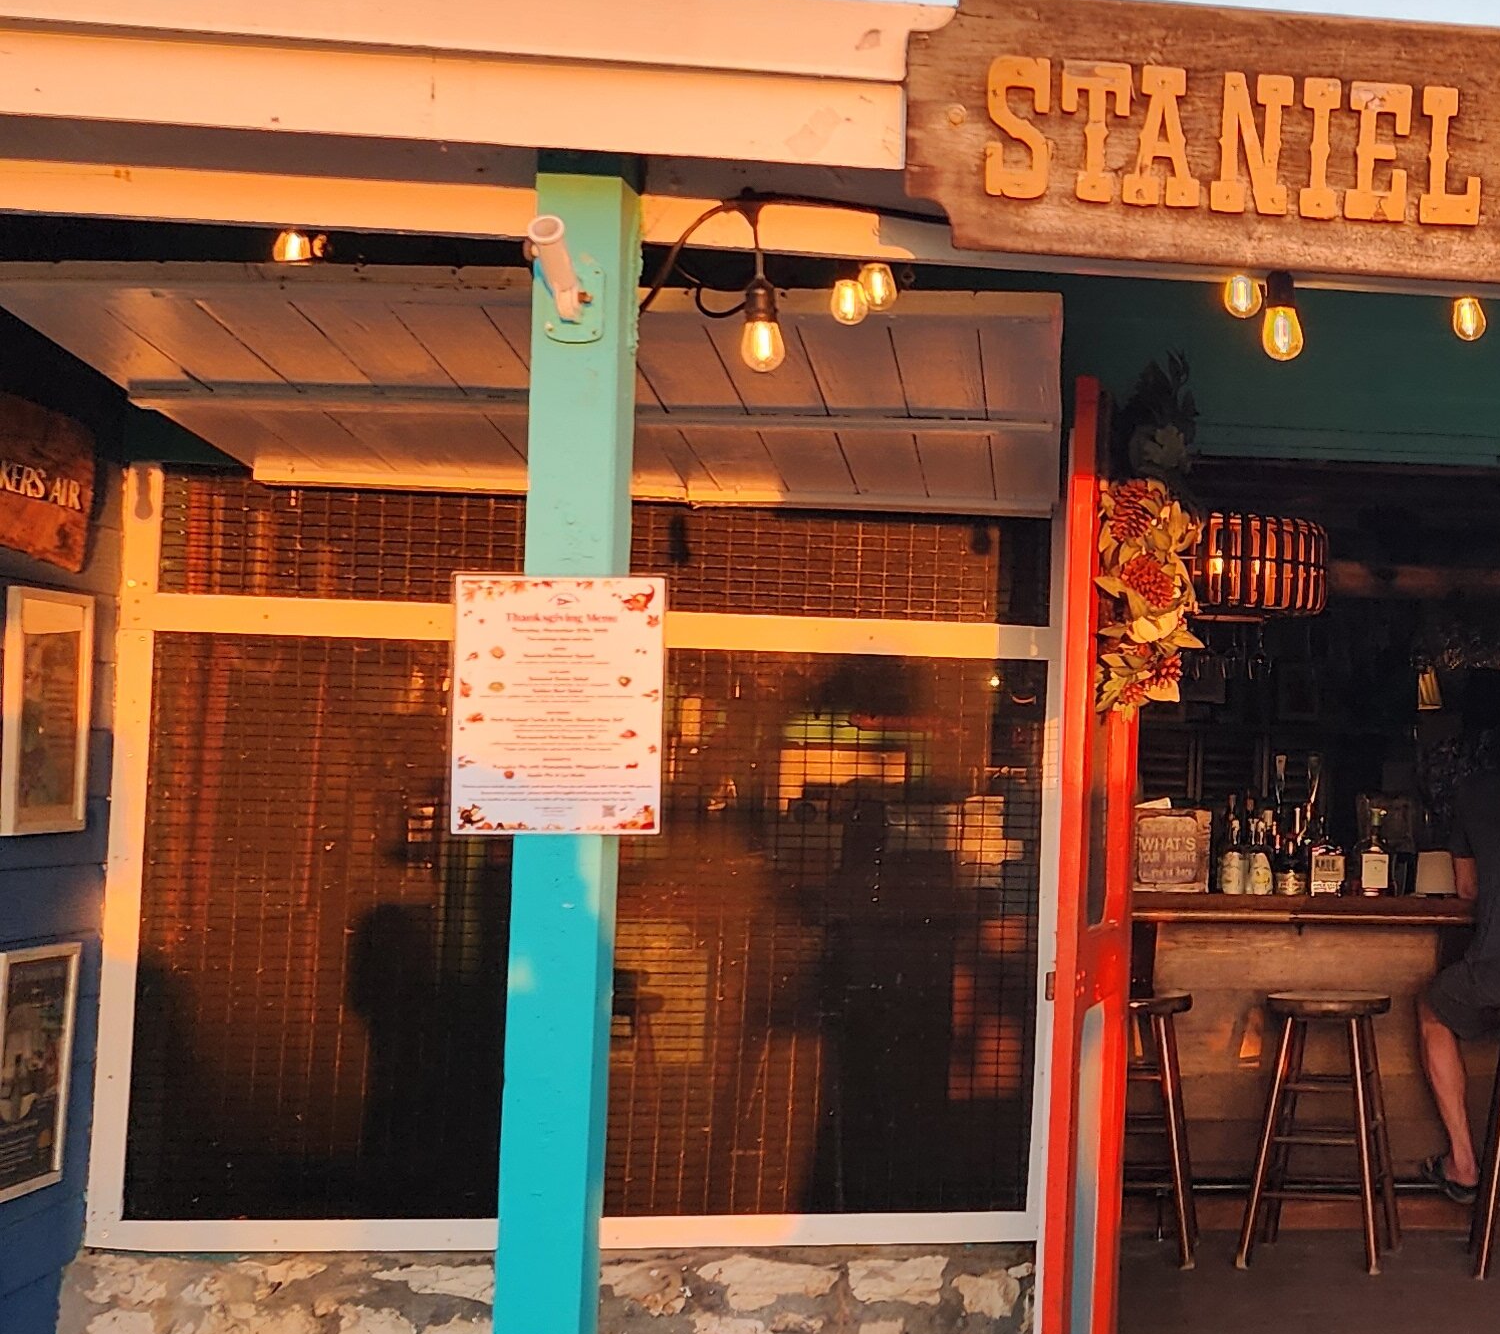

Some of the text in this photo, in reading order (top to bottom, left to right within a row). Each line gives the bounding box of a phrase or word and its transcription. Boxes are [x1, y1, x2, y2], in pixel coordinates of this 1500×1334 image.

[984, 55, 1482, 227] STANIEL
[50, 477, 82, 510] AIR
[505, 612, 618, 624] Thanksgiving Menu
[1139, 837, 1197, 852] WHAT'S
